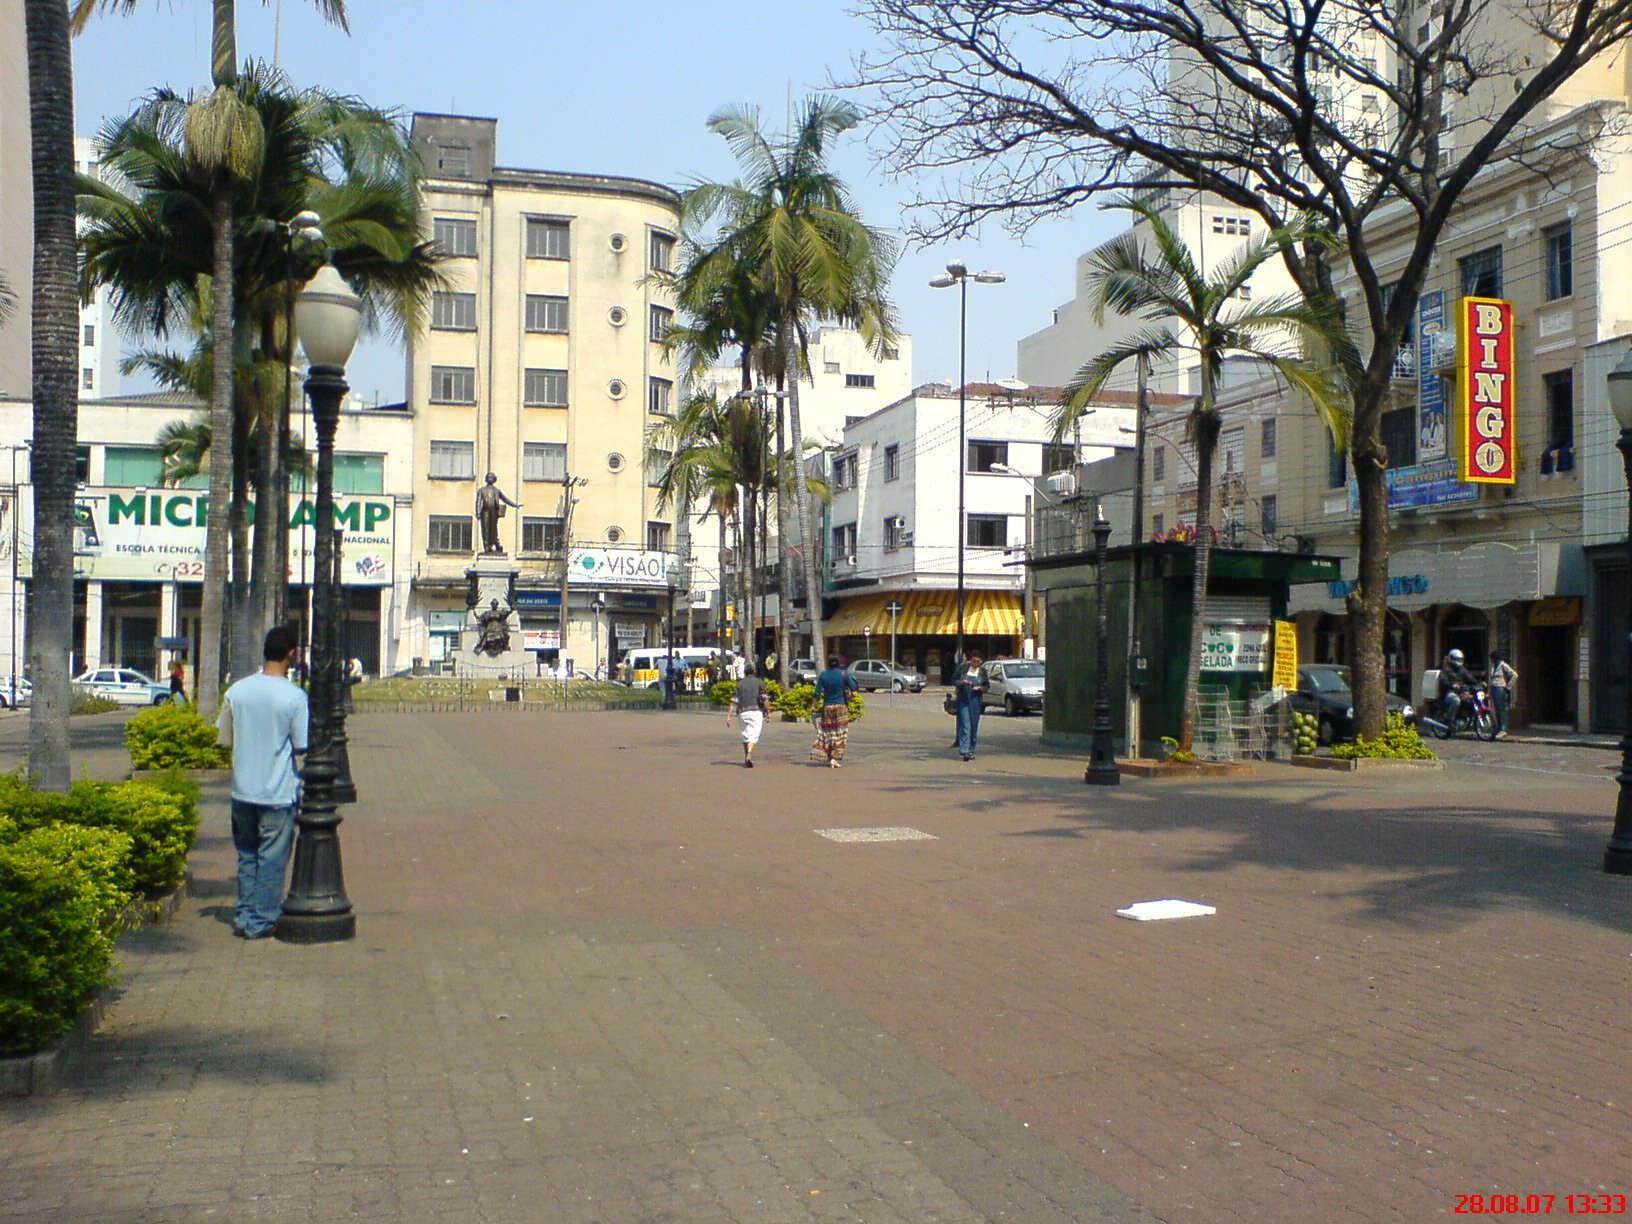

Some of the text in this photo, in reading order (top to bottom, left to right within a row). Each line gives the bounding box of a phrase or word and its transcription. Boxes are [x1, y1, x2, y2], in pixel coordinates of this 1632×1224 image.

[1475, 304, 1506, 474] BINGO
[109, 493, 391, 531] MICAMP
[116, 544, 201, 554] ESCOLA TÉCNICA
[1210, 624, 1222, 636] DE
